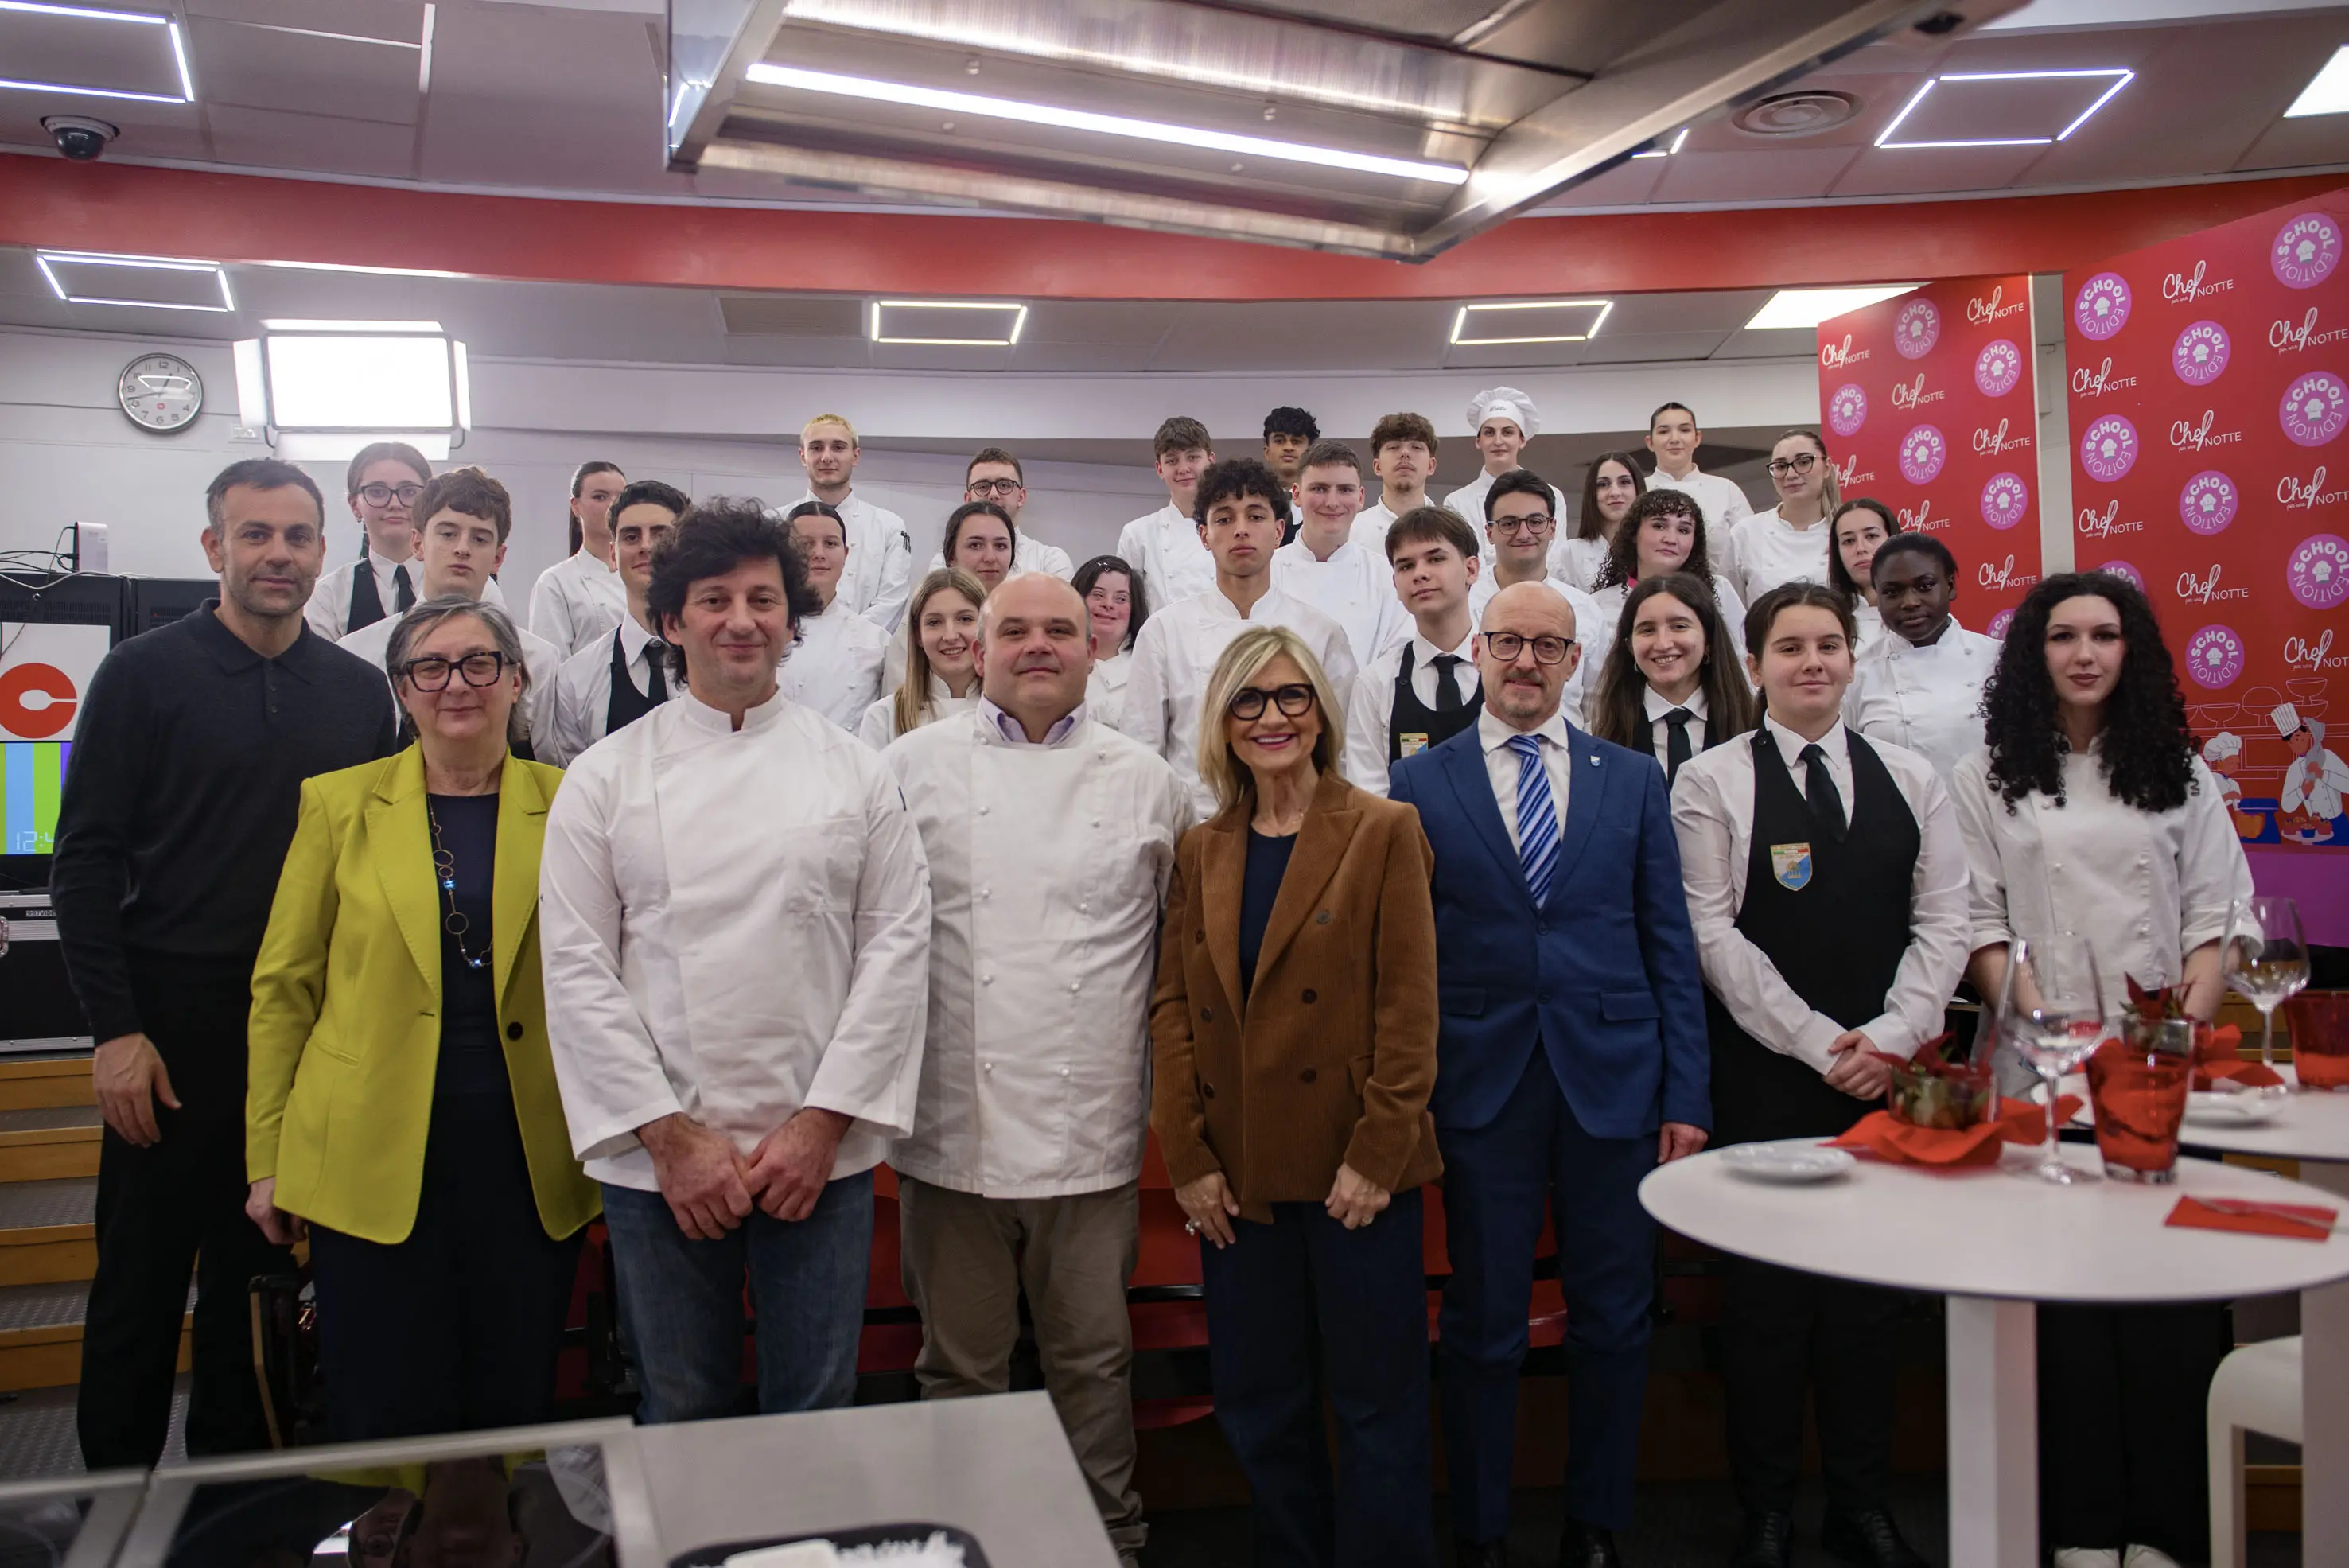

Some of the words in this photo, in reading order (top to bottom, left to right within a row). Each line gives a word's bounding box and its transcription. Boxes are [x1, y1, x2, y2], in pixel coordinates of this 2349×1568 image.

[2277, 220, 2335, 255] SCHOOL
[2278, 252, 2334, 283] EDITION
[2079, 278, 2126, 312] SCHOOL
[2163, 260, 2206, 303] Chef
[2197, 279, 2234, 298] NOTTE
[1898, 304, 1936, 333] SCHOOL
[1967, 286, 2002, 324] Chef
[1994, 302, 2024, 318] NOTTE
[2079, 307, 2125, 334] EDITION
[2269, 307, 2318, 352] Chef
[1822, 334, 1852, 368] Chef
[1898, 329, 1935, 355] EDITION
[2178, 326, 2225, 357] SCHOOL
[2308, 329, 2349, 346] NOTTE
[1845, 350, 1870, 364] NOTTE
[1979, 344, 2017, 372] SCHOOL
[2178, 354, 2223, 380] EDITION
[1892, 373, 1925, 409] Chef
[1979, 368, 2016, 392] EDITION
[2072, 357, 2112, 398] Chef
[2103, 376, 2137, 392] NOTTE
[1832, 388, 1865, 413] SCHOOL
[1918, 390, 1945, 405] NOTTE
[2286, 379, 2344, 412] SCHOOL
[1832, 410, 1863, 433] EDITION
[2170, 410, 2214, 451] Chef
[2286, 410, 2343, 440] EDITION
[1903, 430, 1942, 457] SCHOOL
[1973, 418, 2009, 455] Chef
[2001, 437, 2031, 451] NOTTE
[2086, 421, 2133, 450] SCHOOL
[2204, 432, 2242, 447] NOTTE
[1903, 457, 1941, 480] EDITION
[2086, 451, 2132, 477] EDITION
[1850, 472, 1875, 484] NOTTE
[1985, 477, 2024, 504] SCHOOL
[2185, 477, 2233, 505] SCHOOL
[2277, 466, 2326, 510] Chef
[2316, 491, 2349, 505] NOTT
[1897, 500, 1930, 532] Chef
[1923, 519, 1950, 531] NOTTE
[1985, 504, 2022, 525] EDITION
[2079, 500, 2118, 539] Chef
[2110, 521, 2144, 535] NOTTE
[2185, 505, 2231, 530] EDITION
[2293, 541, 2349, 573] SCHOOL
[1978, 554, 2014, 591] Chef
[2006, 575, 2037, 587] NOTTE
[2176, 564, 2221, 604] Chef
[2211, 588, 2249, 601] NOTTE
[2293, 574, 2349, 602] EDITION
[2191, 630, 2238, 658] SCHOOL
[2284, 629, 2333, 671] Chef
[2191, 658, 2237, 683] EDITION
[2323, 657, 2349, 667] NOT
